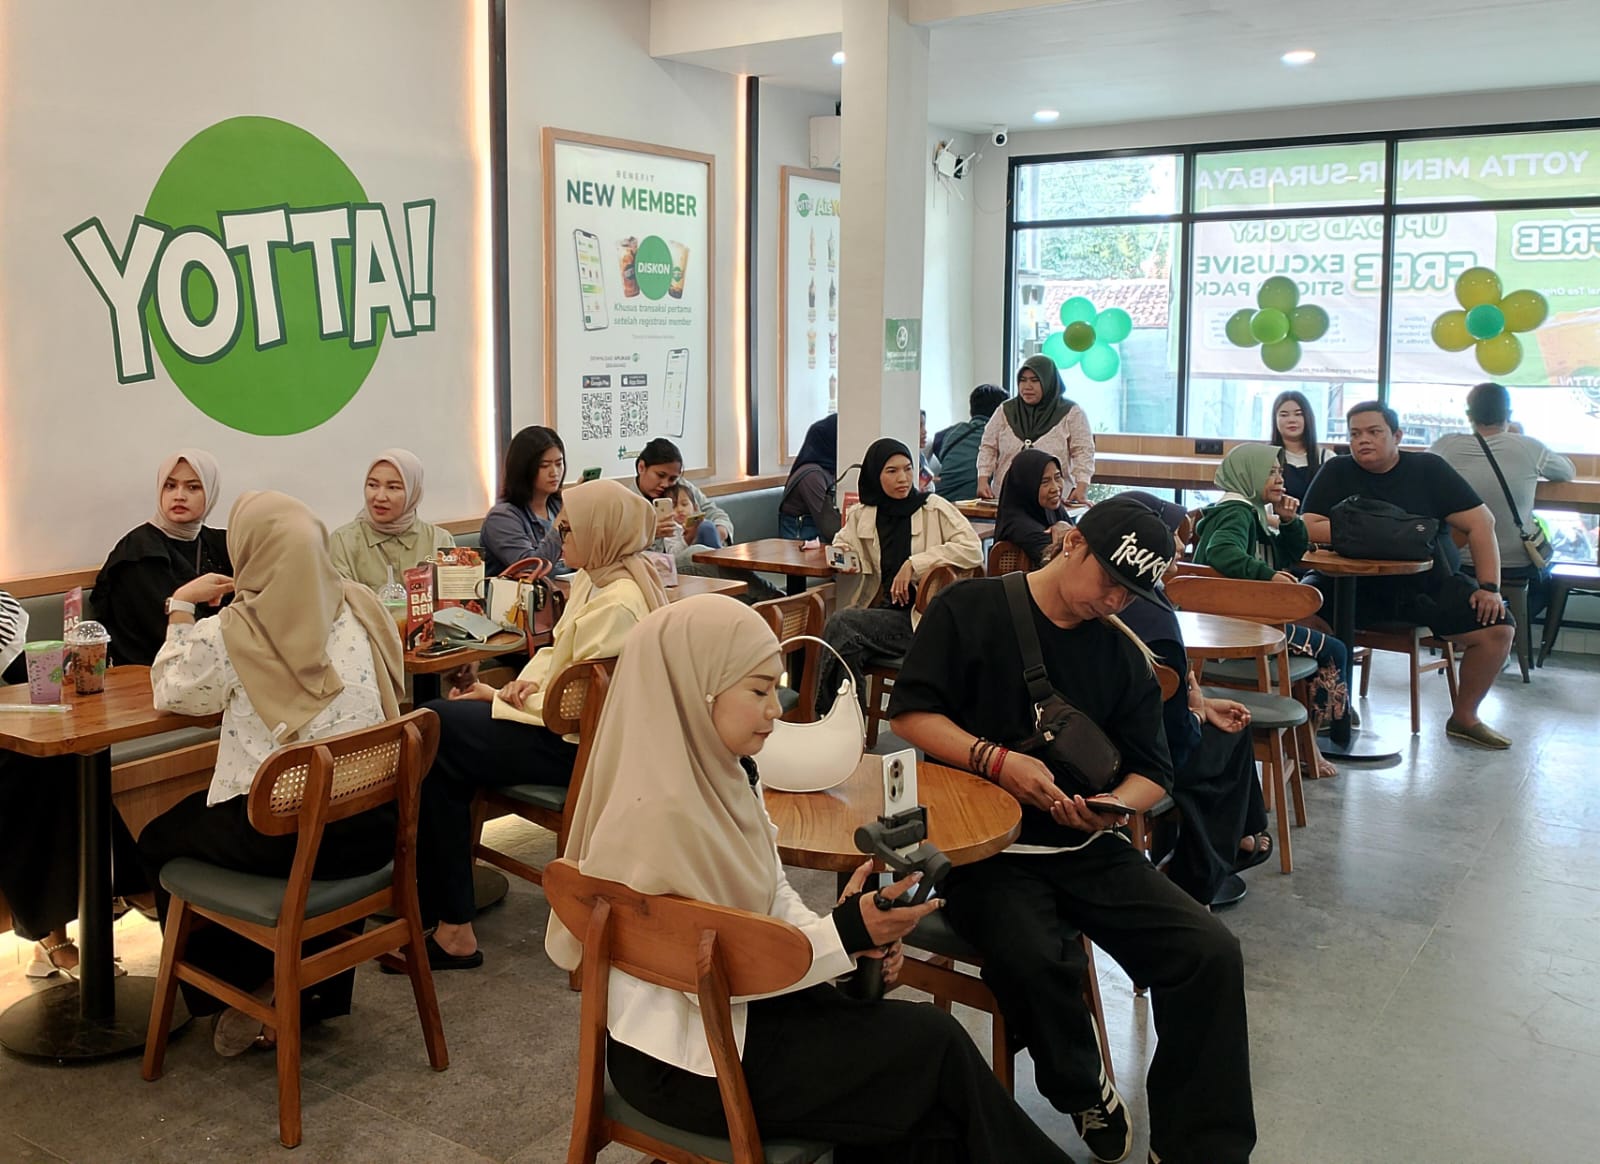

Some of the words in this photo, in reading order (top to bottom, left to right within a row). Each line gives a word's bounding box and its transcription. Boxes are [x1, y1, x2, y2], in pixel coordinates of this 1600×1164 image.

[616, 169, 655, 182] BENEFIT
[567, 179, 615, 208] NEW
[621, 186, 697, 217] MEMBER
[638, 262, 671, 275] DISKON
[63, 198, 436, 384] YOTTA!
[614, 303, 637, 312] Khusus
[639, 304, 667, 313] transaksi
[667, 305, 692, 315] pertama
[614, 316, 638, 325] setelah
[638, 317, 667, 328] registrasi
[668, 318, 692, 326] member
